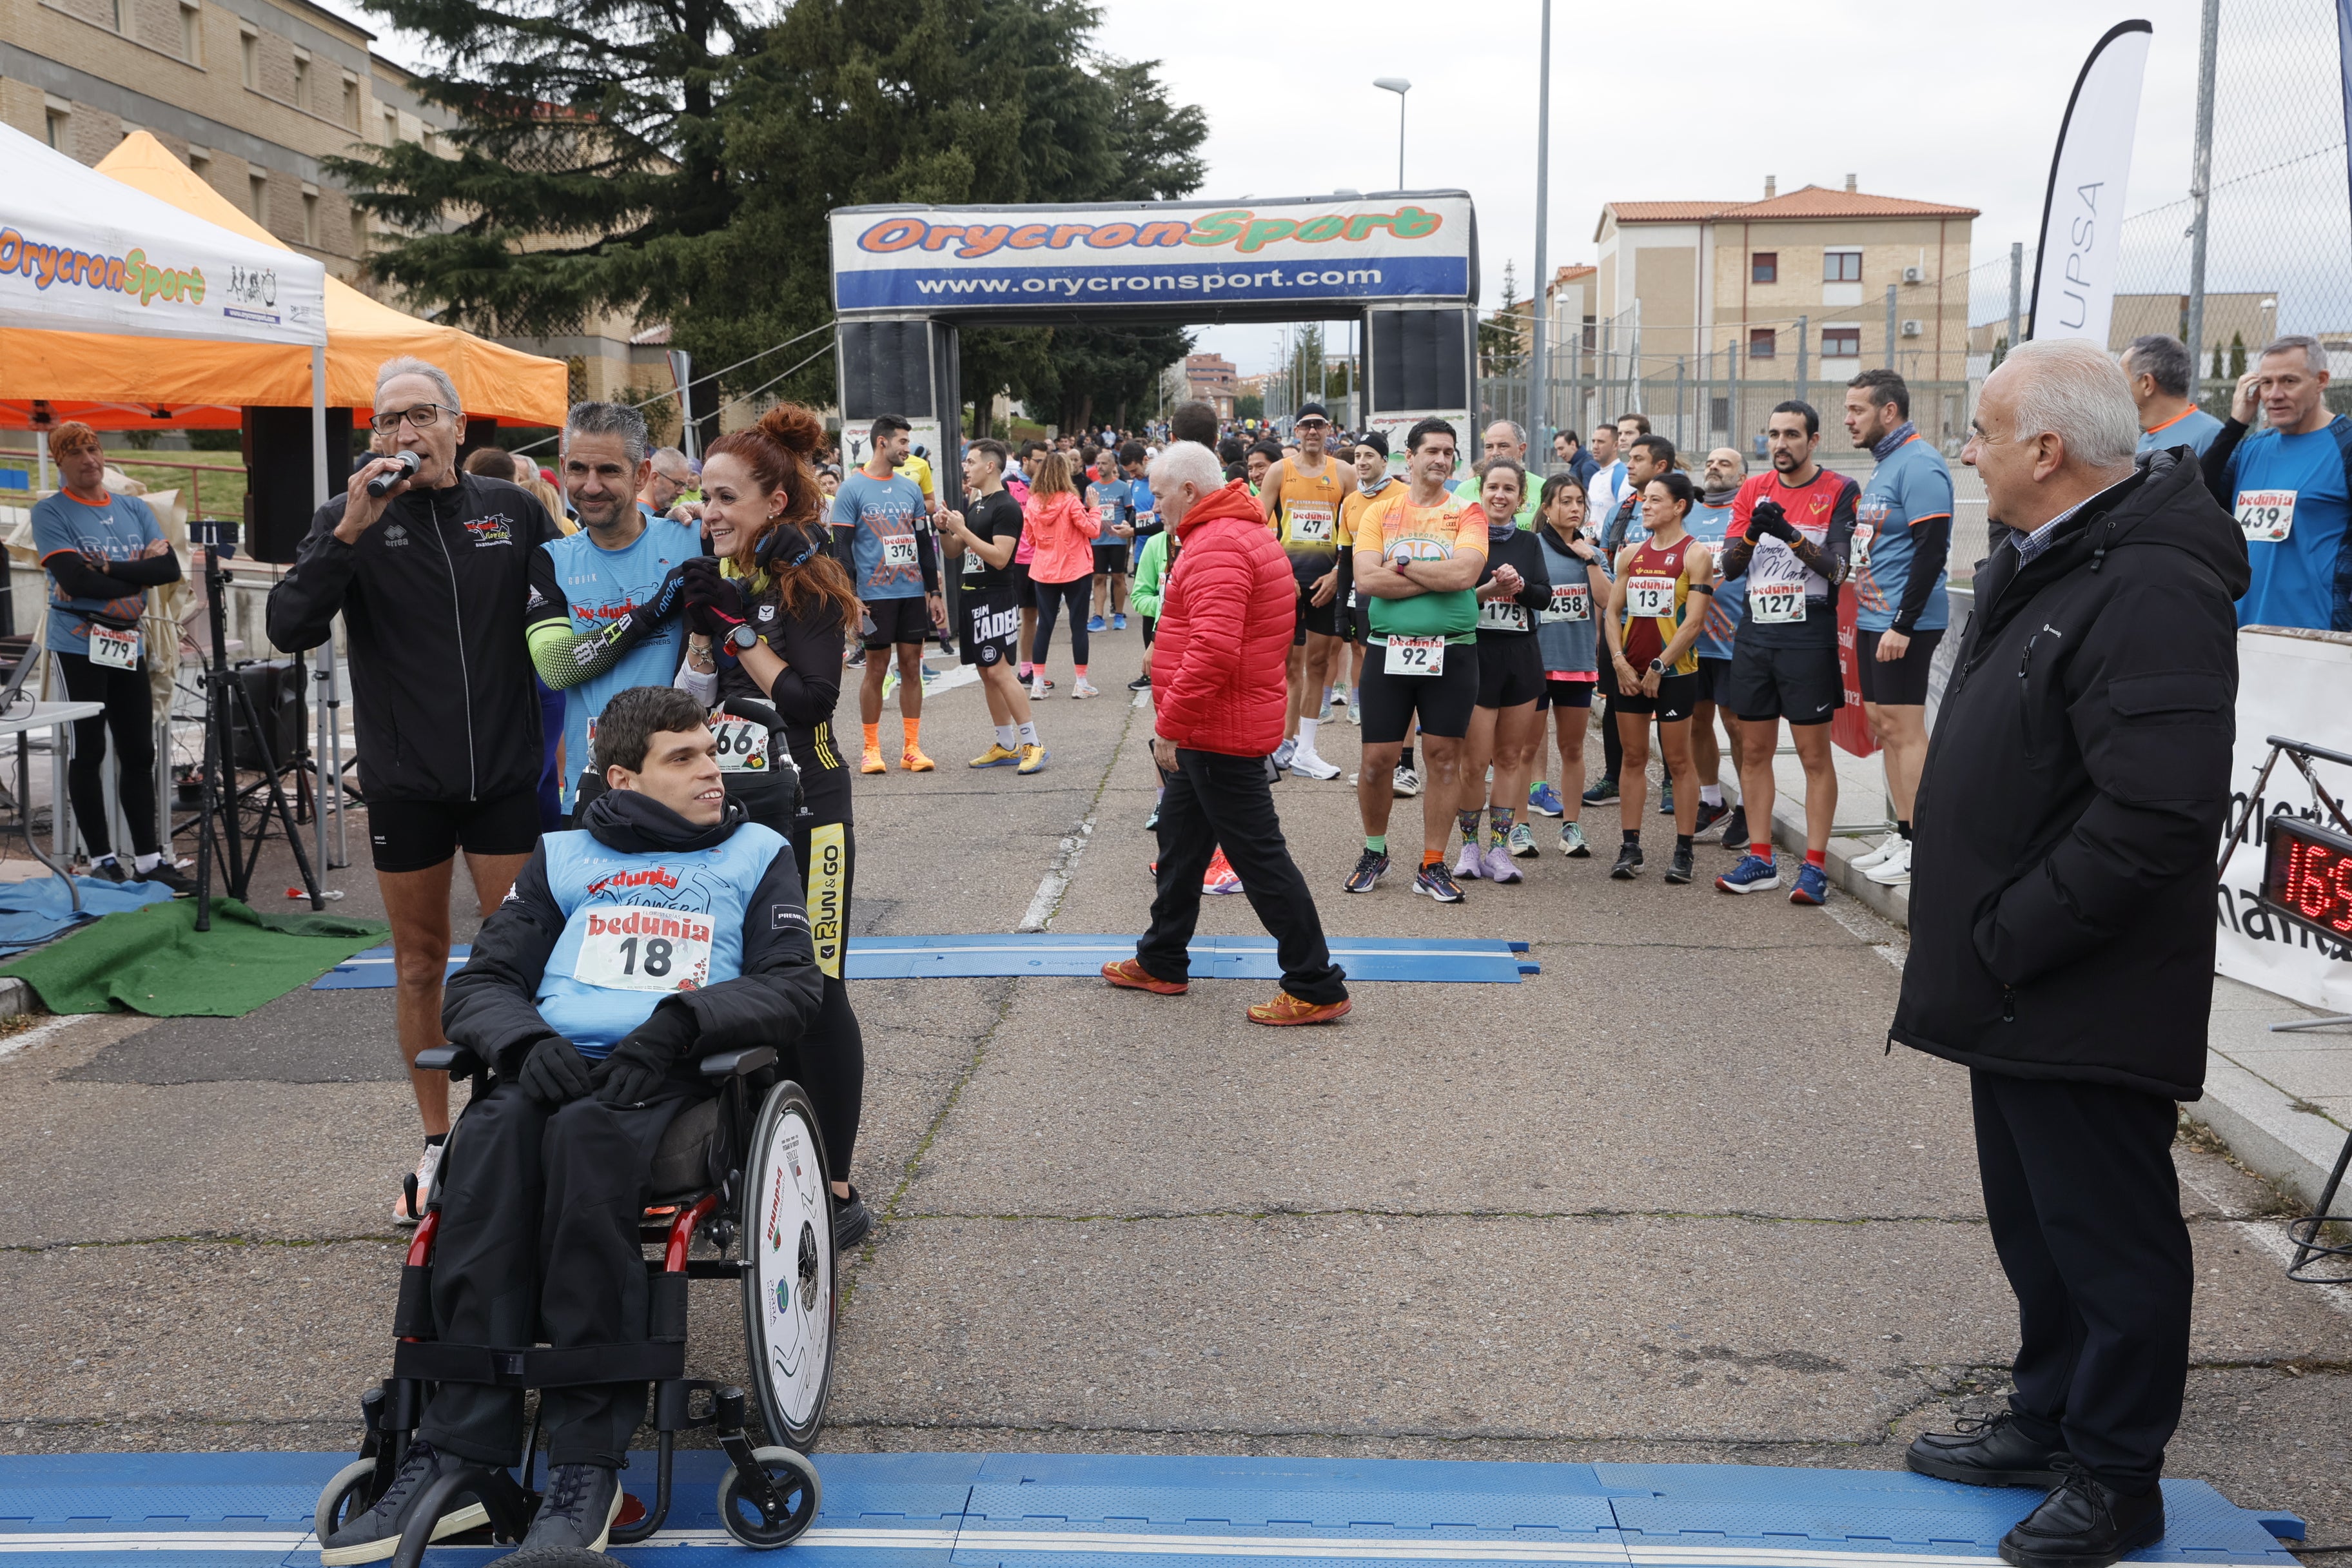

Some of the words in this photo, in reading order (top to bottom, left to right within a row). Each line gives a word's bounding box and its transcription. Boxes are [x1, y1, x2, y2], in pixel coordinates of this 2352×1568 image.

[857, 206, 1443, 259] OrycronSport
[2059, 182, 2104, 329] UPSA
[0, 226, 206, 307] OrycronSport
[916, 266, 1382, 297] www.orycronsport.com
[2238, 494, 2293, 506] bedunia
[1303, 520, 1321, 533] 47
[2240, 507, 2280, 529] 439
[385, 537, 409, 547] errea
[884, 537, 916, 545] bedunia
[1386, 533, 1405, 549] CLUB
[1408, 532, 1450, 549] DEPORTIVO
[891, 544, 913, 558] 376
[1628, 580, 1673, 591] bedunia
[1752, 583, 1803, 595] bedunia
[1549, 596, 1582, 613] 458
[1638, 591, 1658, 607] 13
[1759, 594, 1795, 613] 127
[972, 603, 990, 620] TEAM
[1487, 603, 1520, 621] 175
[973, 604, 1019, 645] CADEN
[99, 638, 129, 659] 779
[1402, 647, 1427, 665] 92
[823, 845, 838, 876] GO
[825, 878, 836, 888] &
[814, 891, 838, 941] RUN
[588, 912, 710, 943] bedunia
[619, 937, 673, 977] 18
[767, 1164, 783, 1241] bedunia
